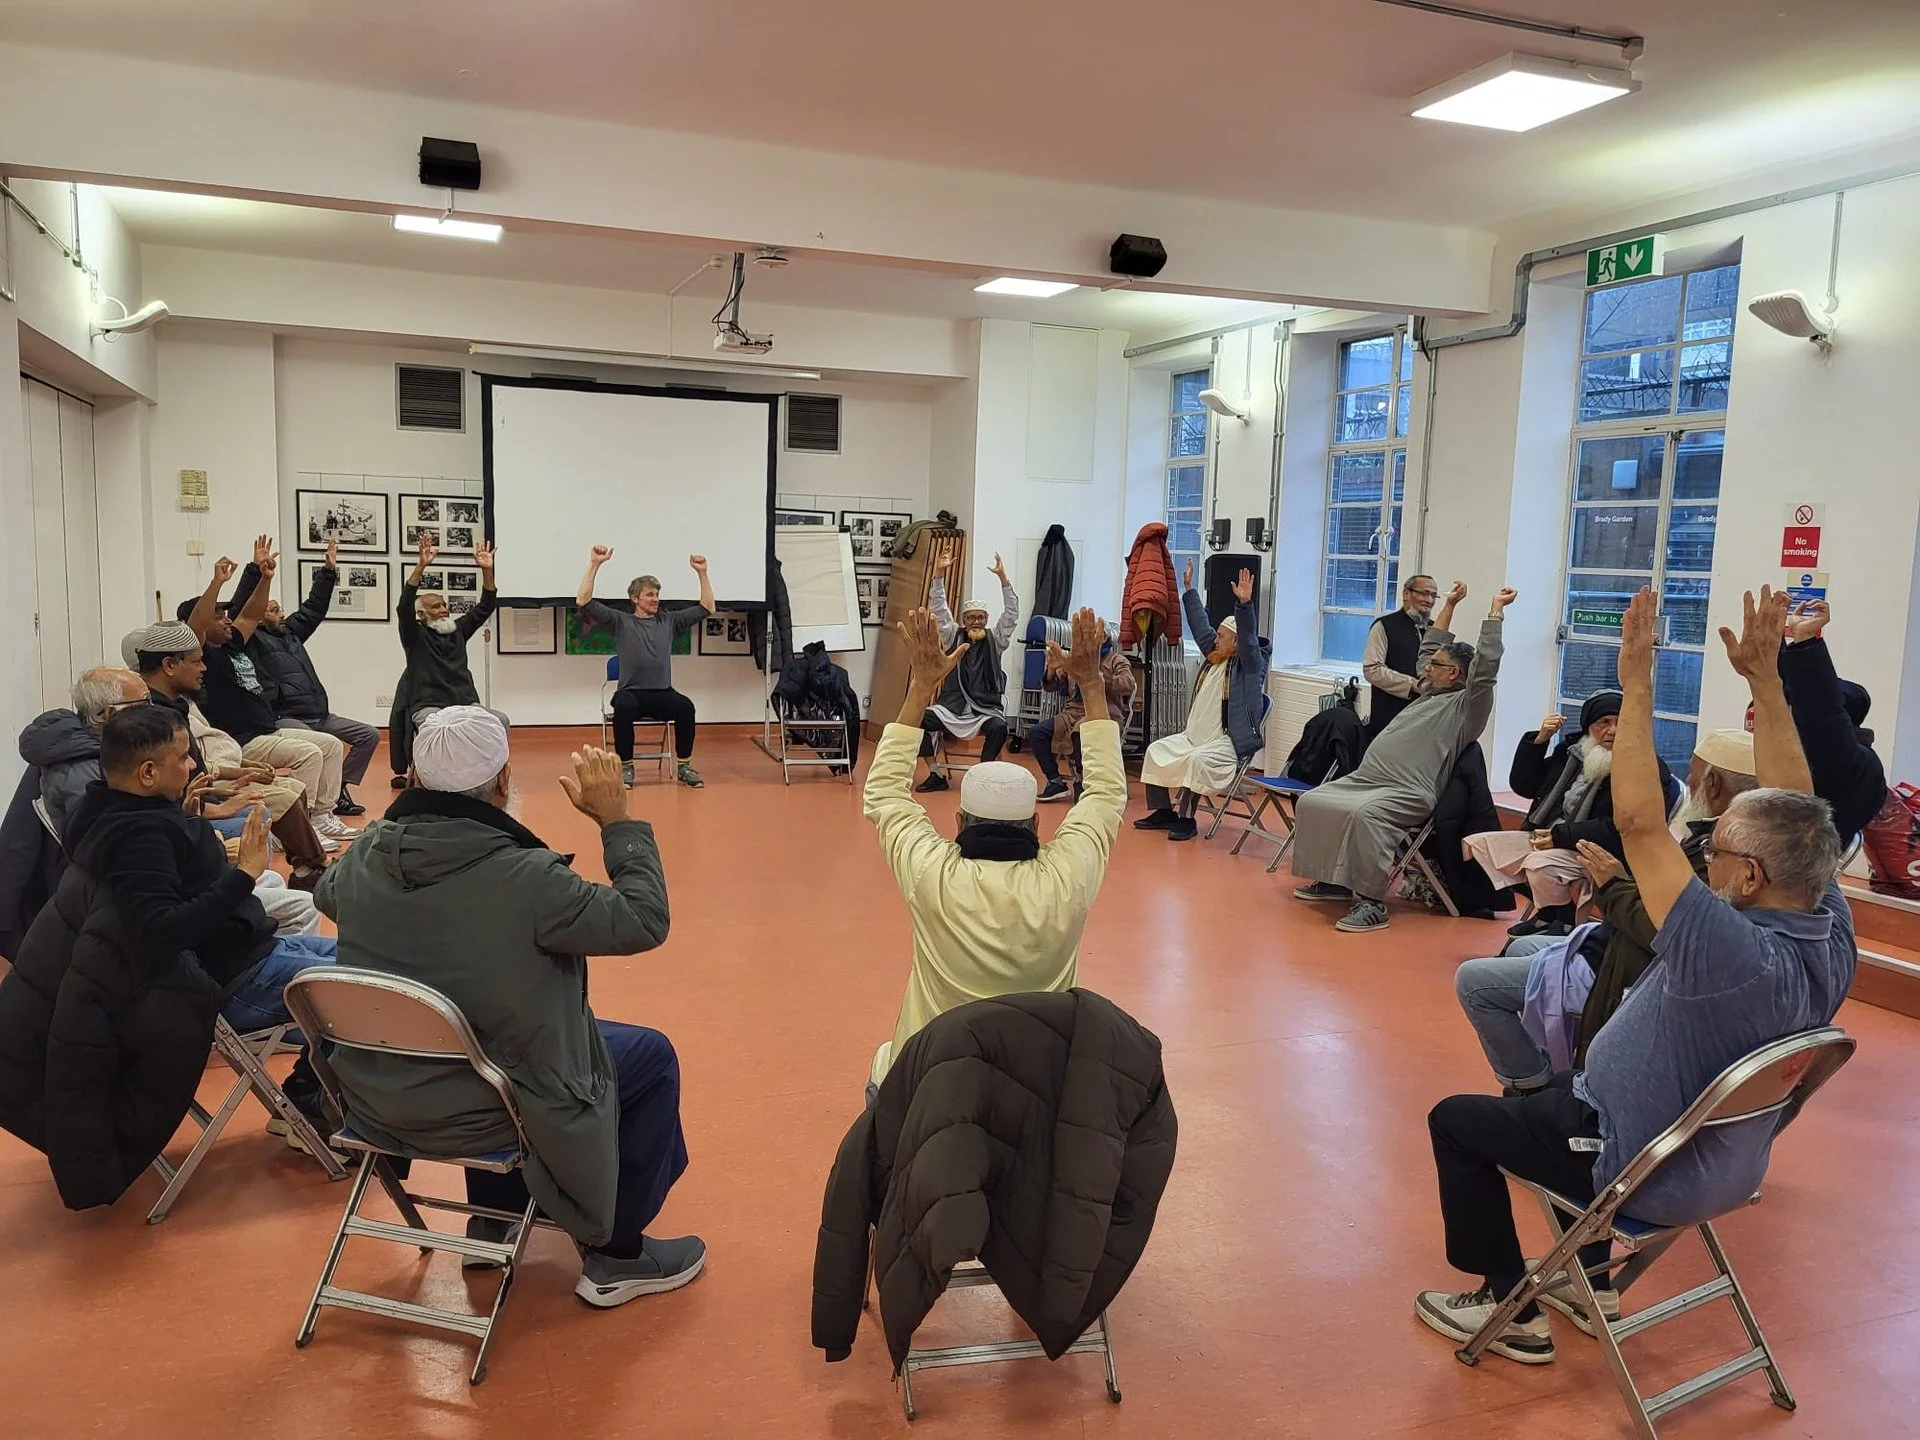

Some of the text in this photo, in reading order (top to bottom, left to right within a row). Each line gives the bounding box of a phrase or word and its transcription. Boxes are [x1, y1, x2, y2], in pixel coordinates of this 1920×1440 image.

[1594, 515, 1633, 524] Brady Garden
[1698, 515, 1716, 524] Brady
[1794, 537, 1807, 545] No
[1783, 548, 1817, 558] smoking
[1576, 612, 1594, 621] Push
[1595, 614, 1608, 622] bar
[1609, 615, 1618, 623] to
